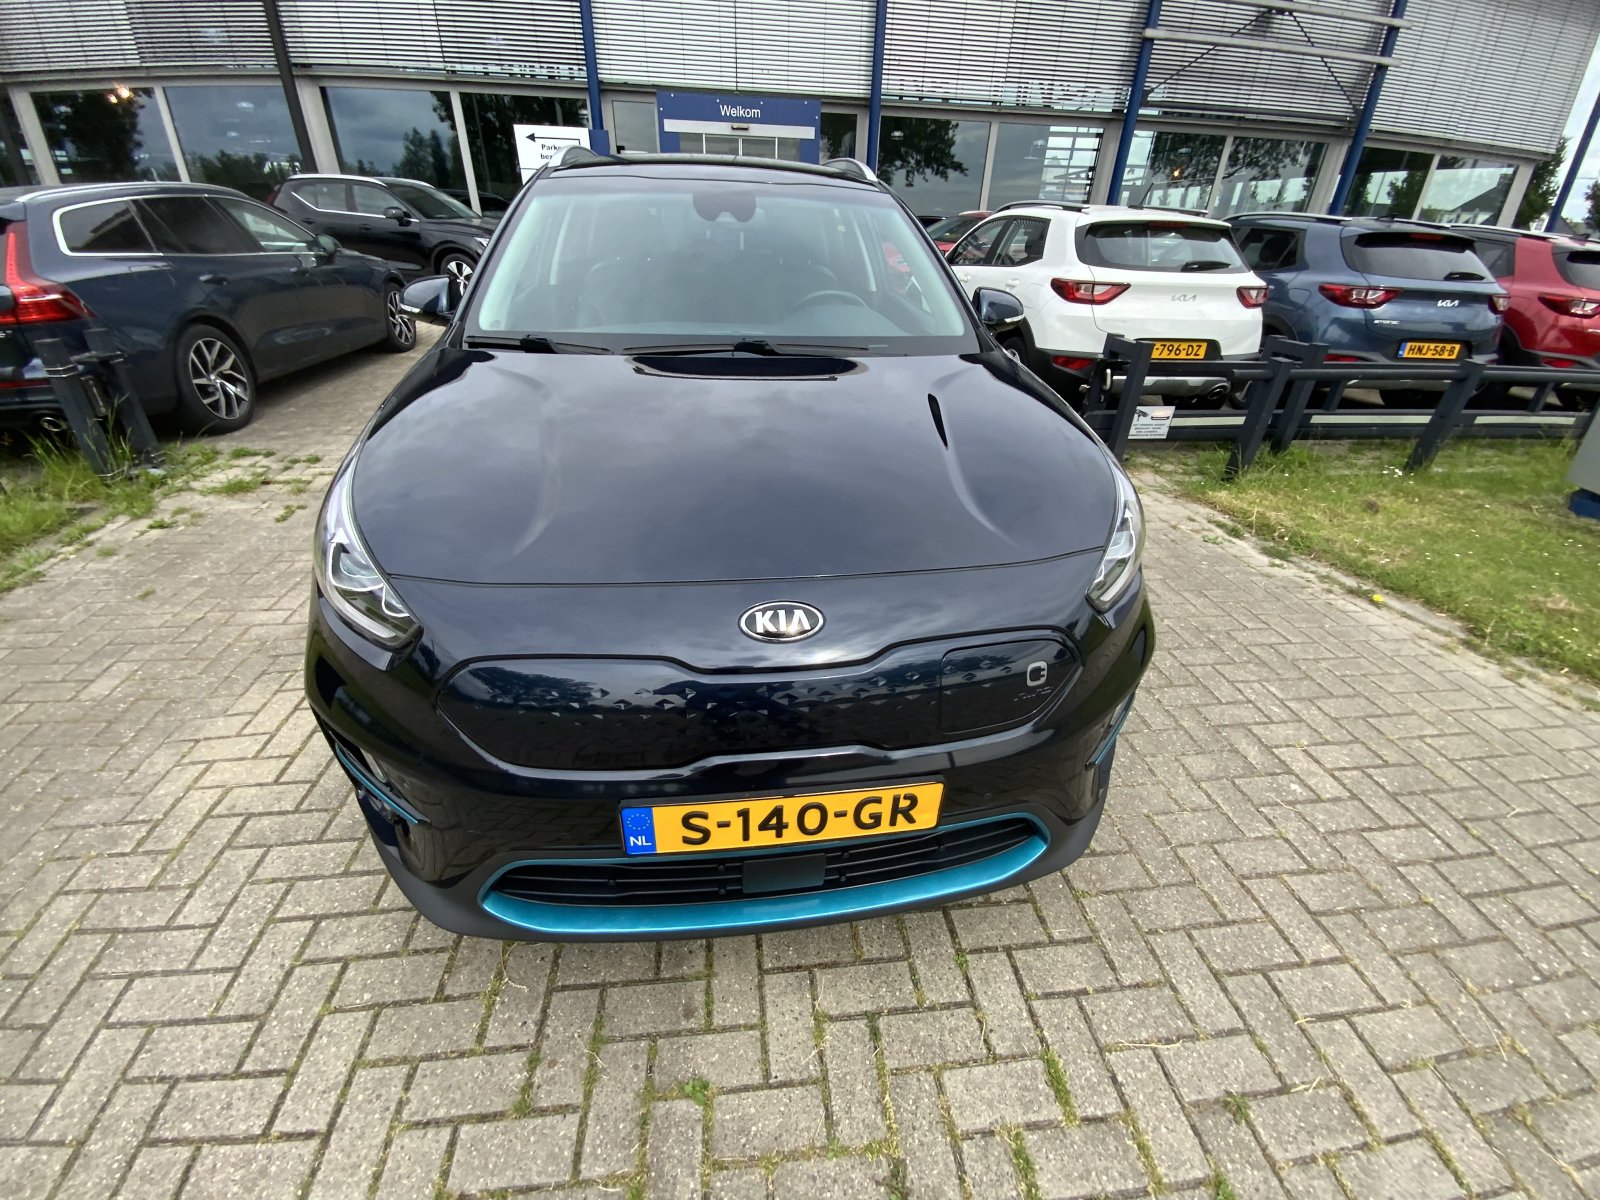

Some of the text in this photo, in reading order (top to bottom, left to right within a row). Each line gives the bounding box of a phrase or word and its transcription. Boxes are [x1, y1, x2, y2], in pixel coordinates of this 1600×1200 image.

[719, 103, 761, 119] Welkom
[1171, 294, 1198, 302] KIA
[1437, 299, 1460, 307] KIA
[1153, 343, 1203, 357] -796-DZ
[1407, 344, 1457, 357] HNJ-58-B
[755, 609, 811, 633] KIA
[629, 793, 919, 848] NL S-140-GR
